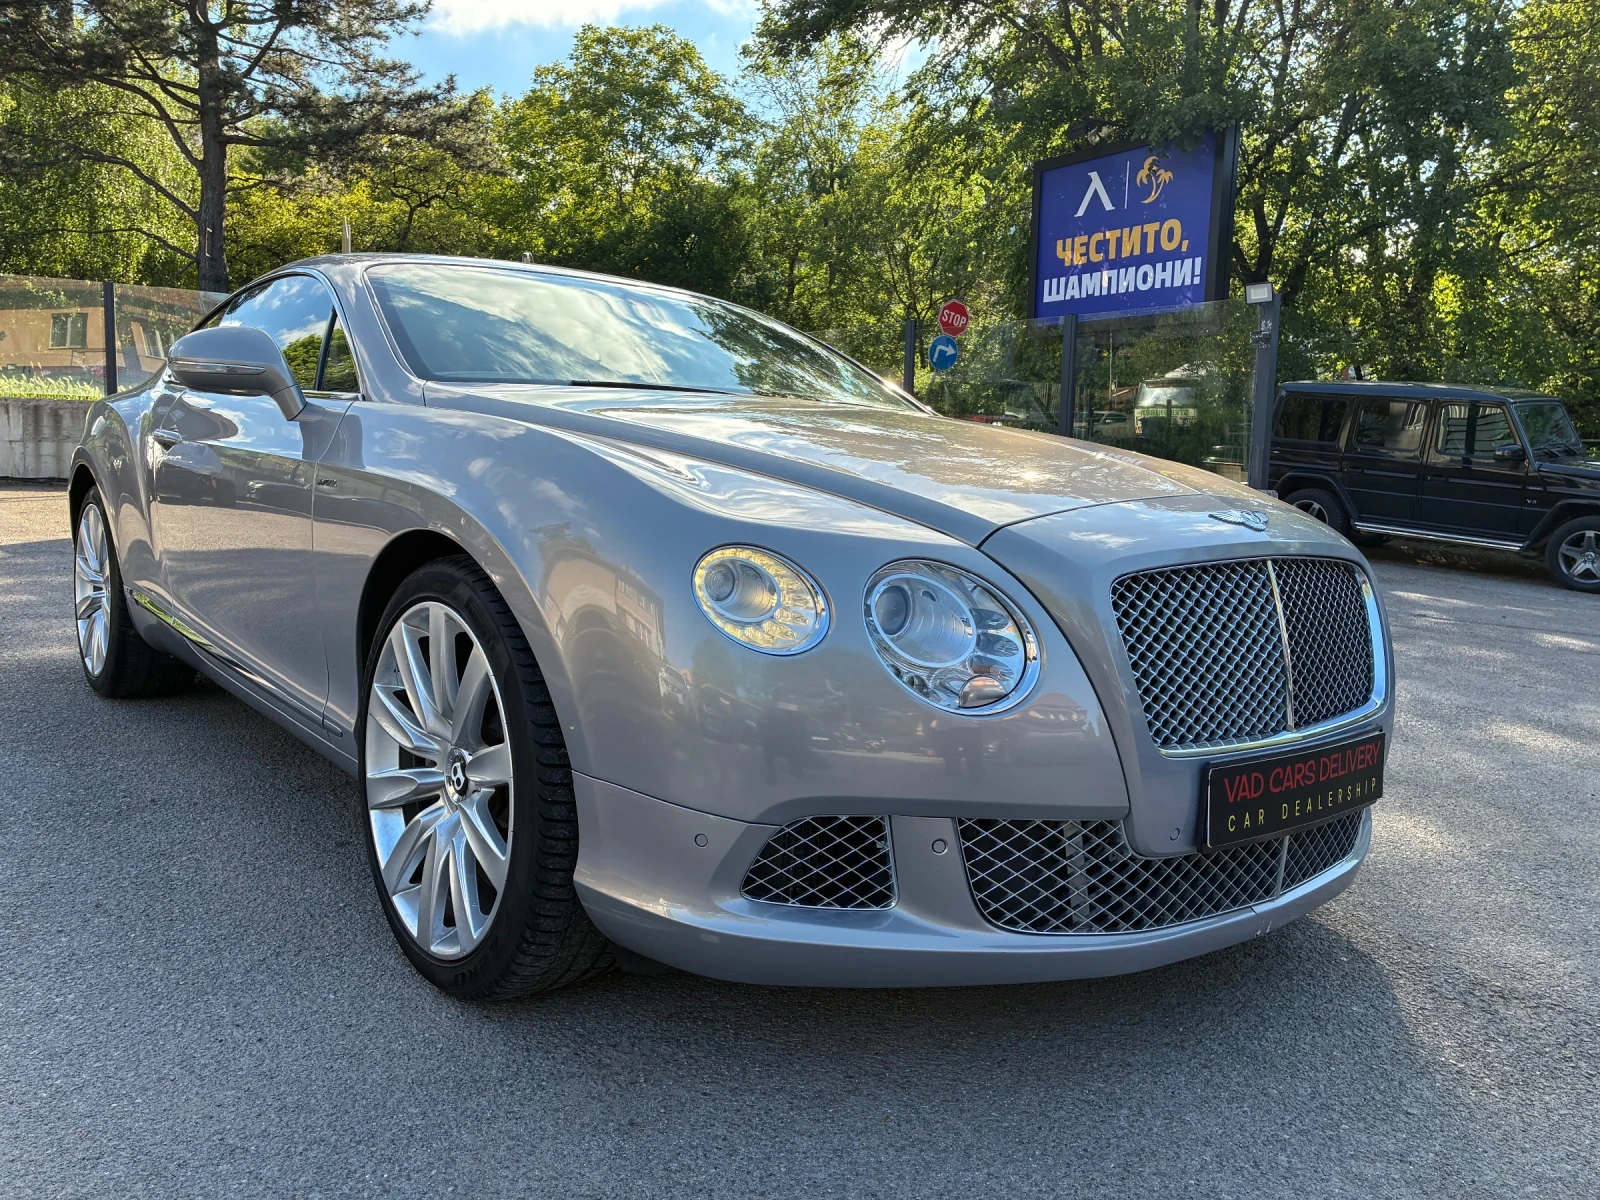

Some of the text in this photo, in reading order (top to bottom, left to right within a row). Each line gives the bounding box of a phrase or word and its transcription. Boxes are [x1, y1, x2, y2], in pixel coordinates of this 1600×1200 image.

[1056, 218, 1189, 266] ЧЕСТИТО,
[1043, 257, 1202, 303] ШАМПИОНИ!
[942, 309, 966, 328] STOP
[1223, 741, 1381, 803] VAD CARS DELIVERY
[1228, 777, 1376, 832] CAR DEALERSHIP
